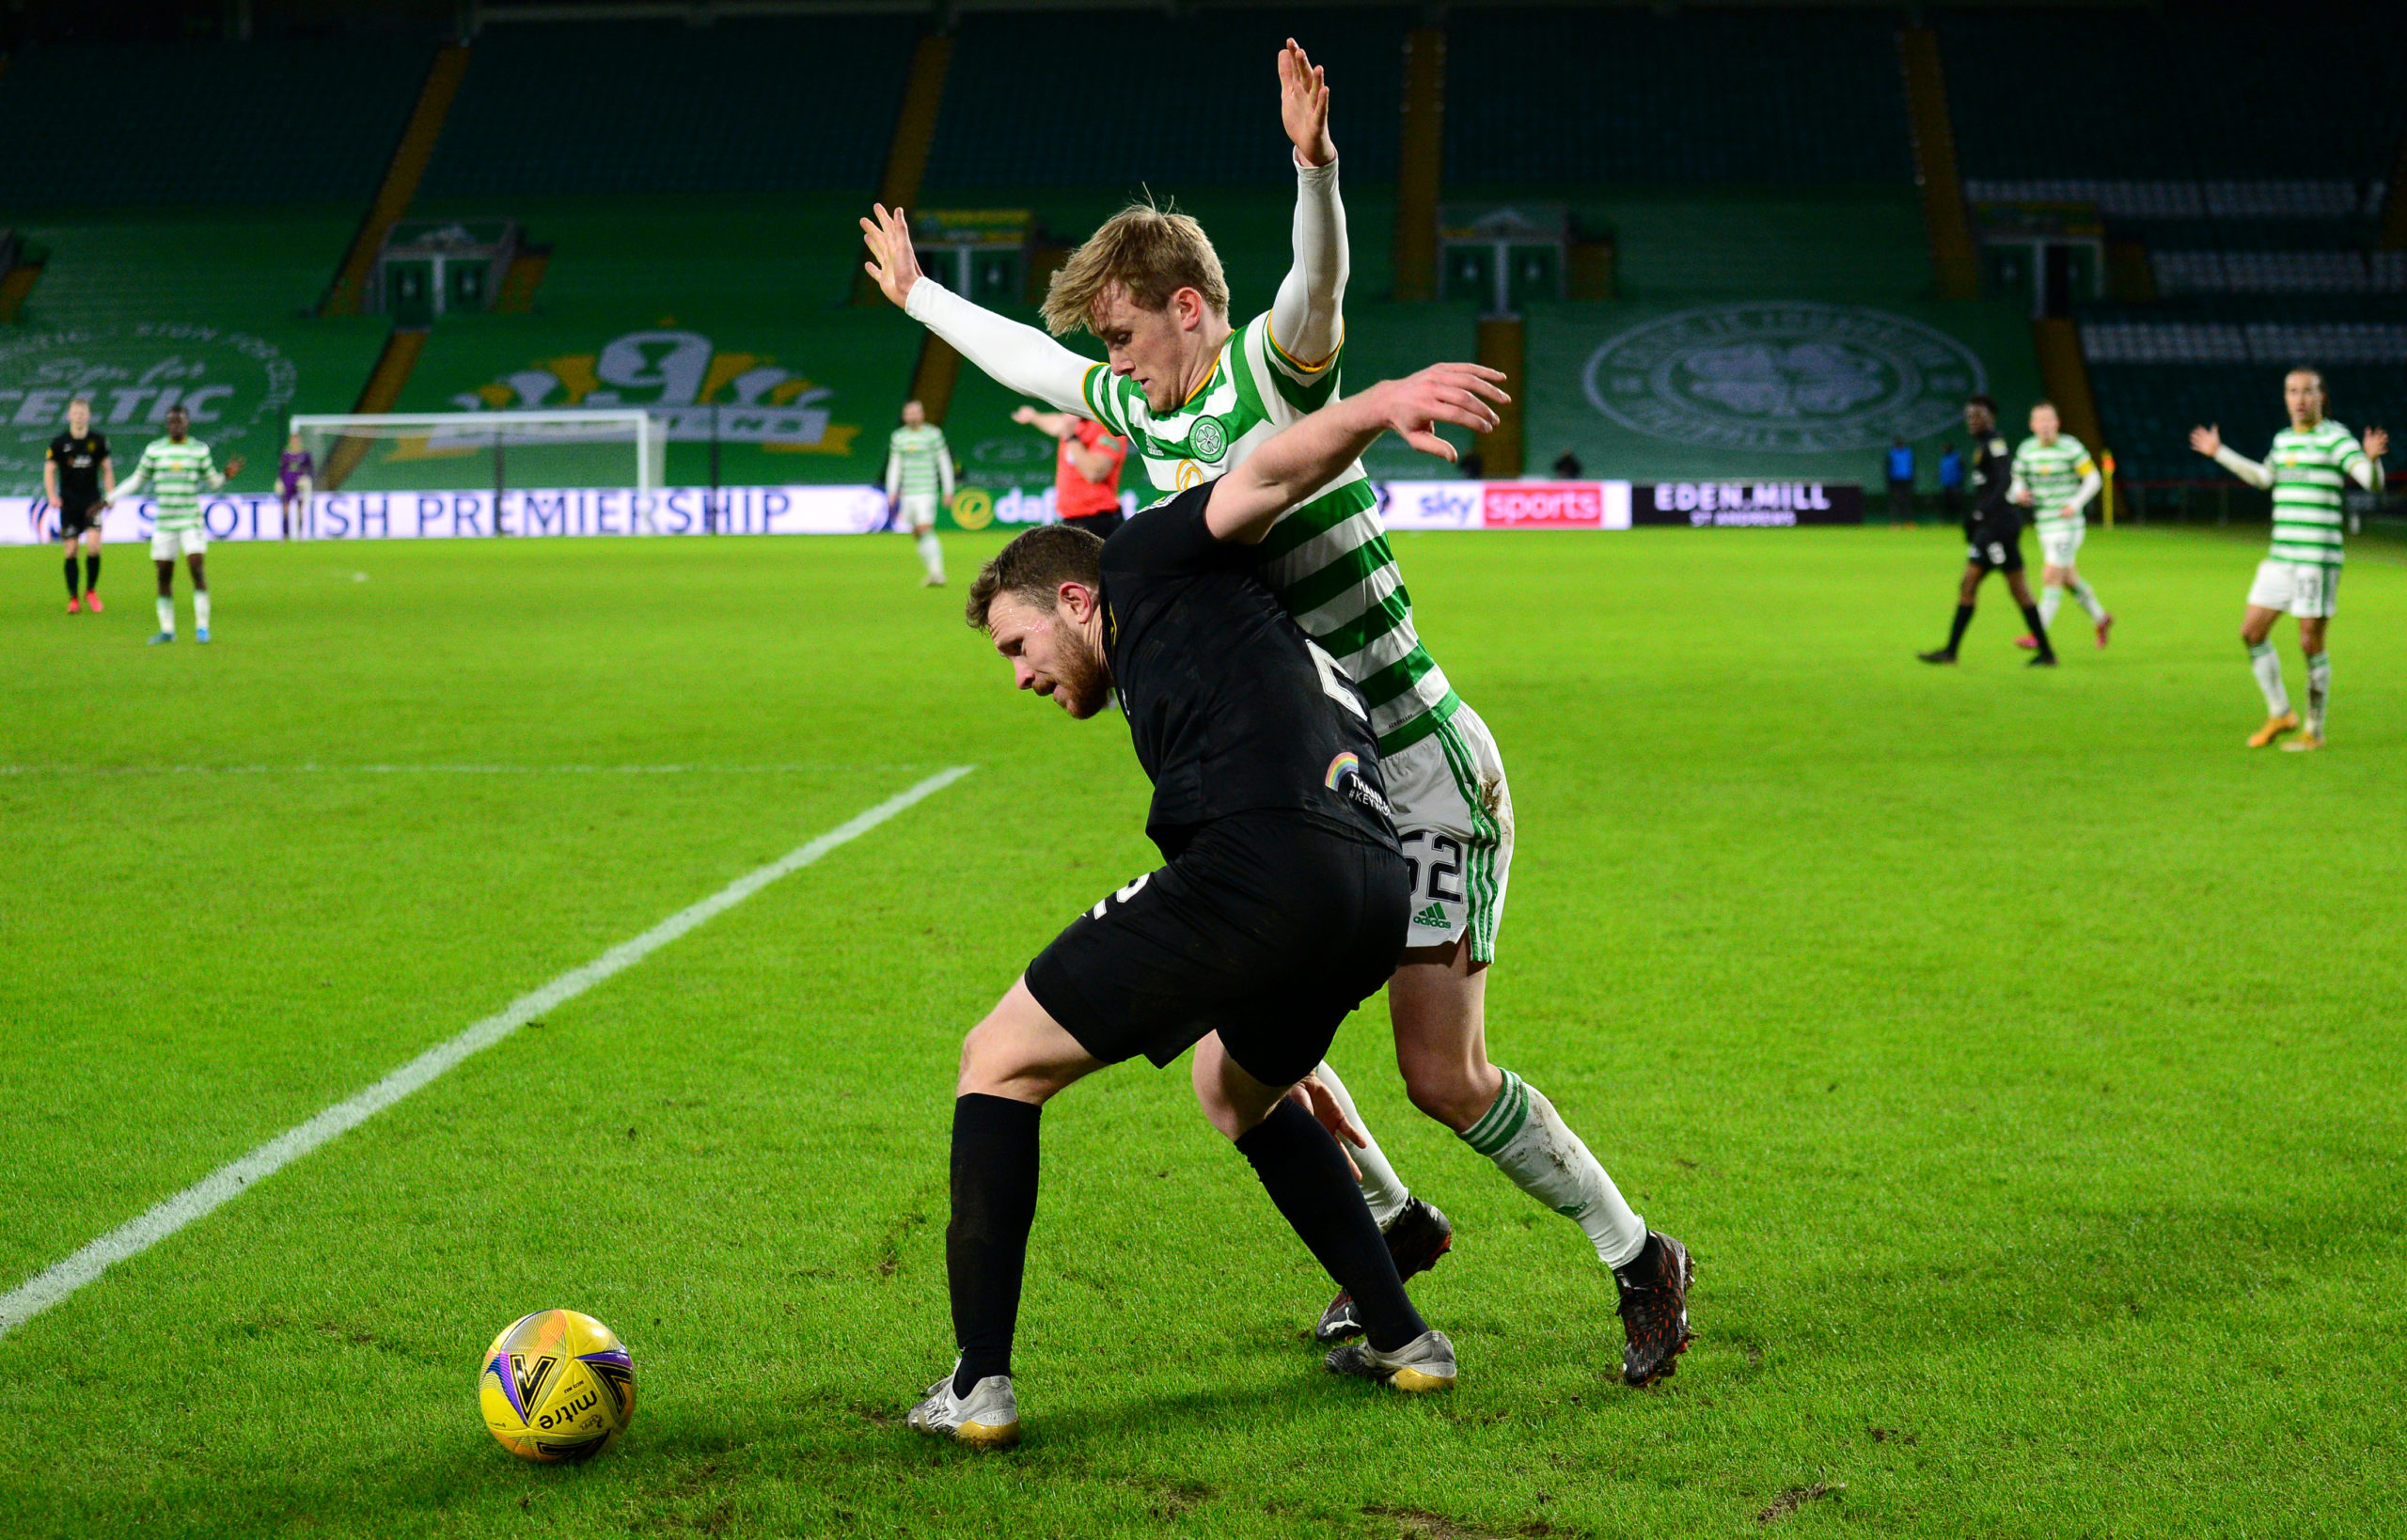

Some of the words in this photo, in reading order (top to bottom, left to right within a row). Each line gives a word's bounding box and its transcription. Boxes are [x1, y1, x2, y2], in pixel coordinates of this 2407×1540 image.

[138, 494, 388, 540] SOTISH
[417, 493, 791, 536] PREMIERSHIP
[994, 486, 1139, 525] daft
[1420, 490, 1474, 526] sky
[1487, 488, 1598, 525] sports
[1413, 916, 1451, 929] adidas
[539, 1390, 597, 1430] mitre
